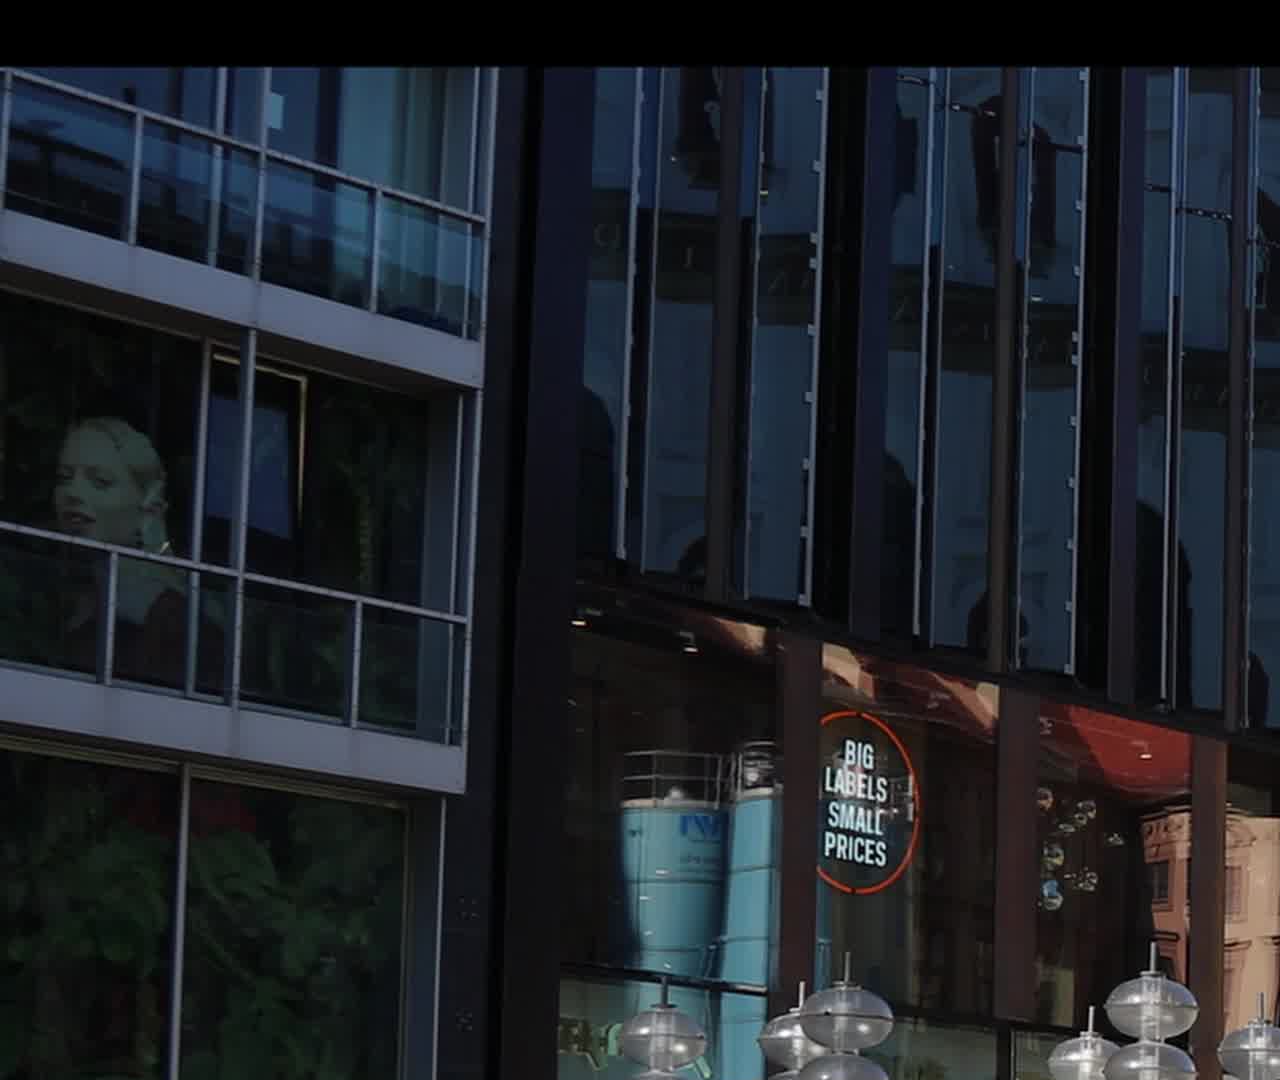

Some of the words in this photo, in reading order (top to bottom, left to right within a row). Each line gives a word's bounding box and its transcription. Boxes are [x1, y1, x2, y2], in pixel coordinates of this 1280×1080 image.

[845, 740, 874, 769] BIG
[825, 766, 887, 802] LABELS
[828, 801, 883, 836] SMALL
[824, 831, 887, 867] PRICES
